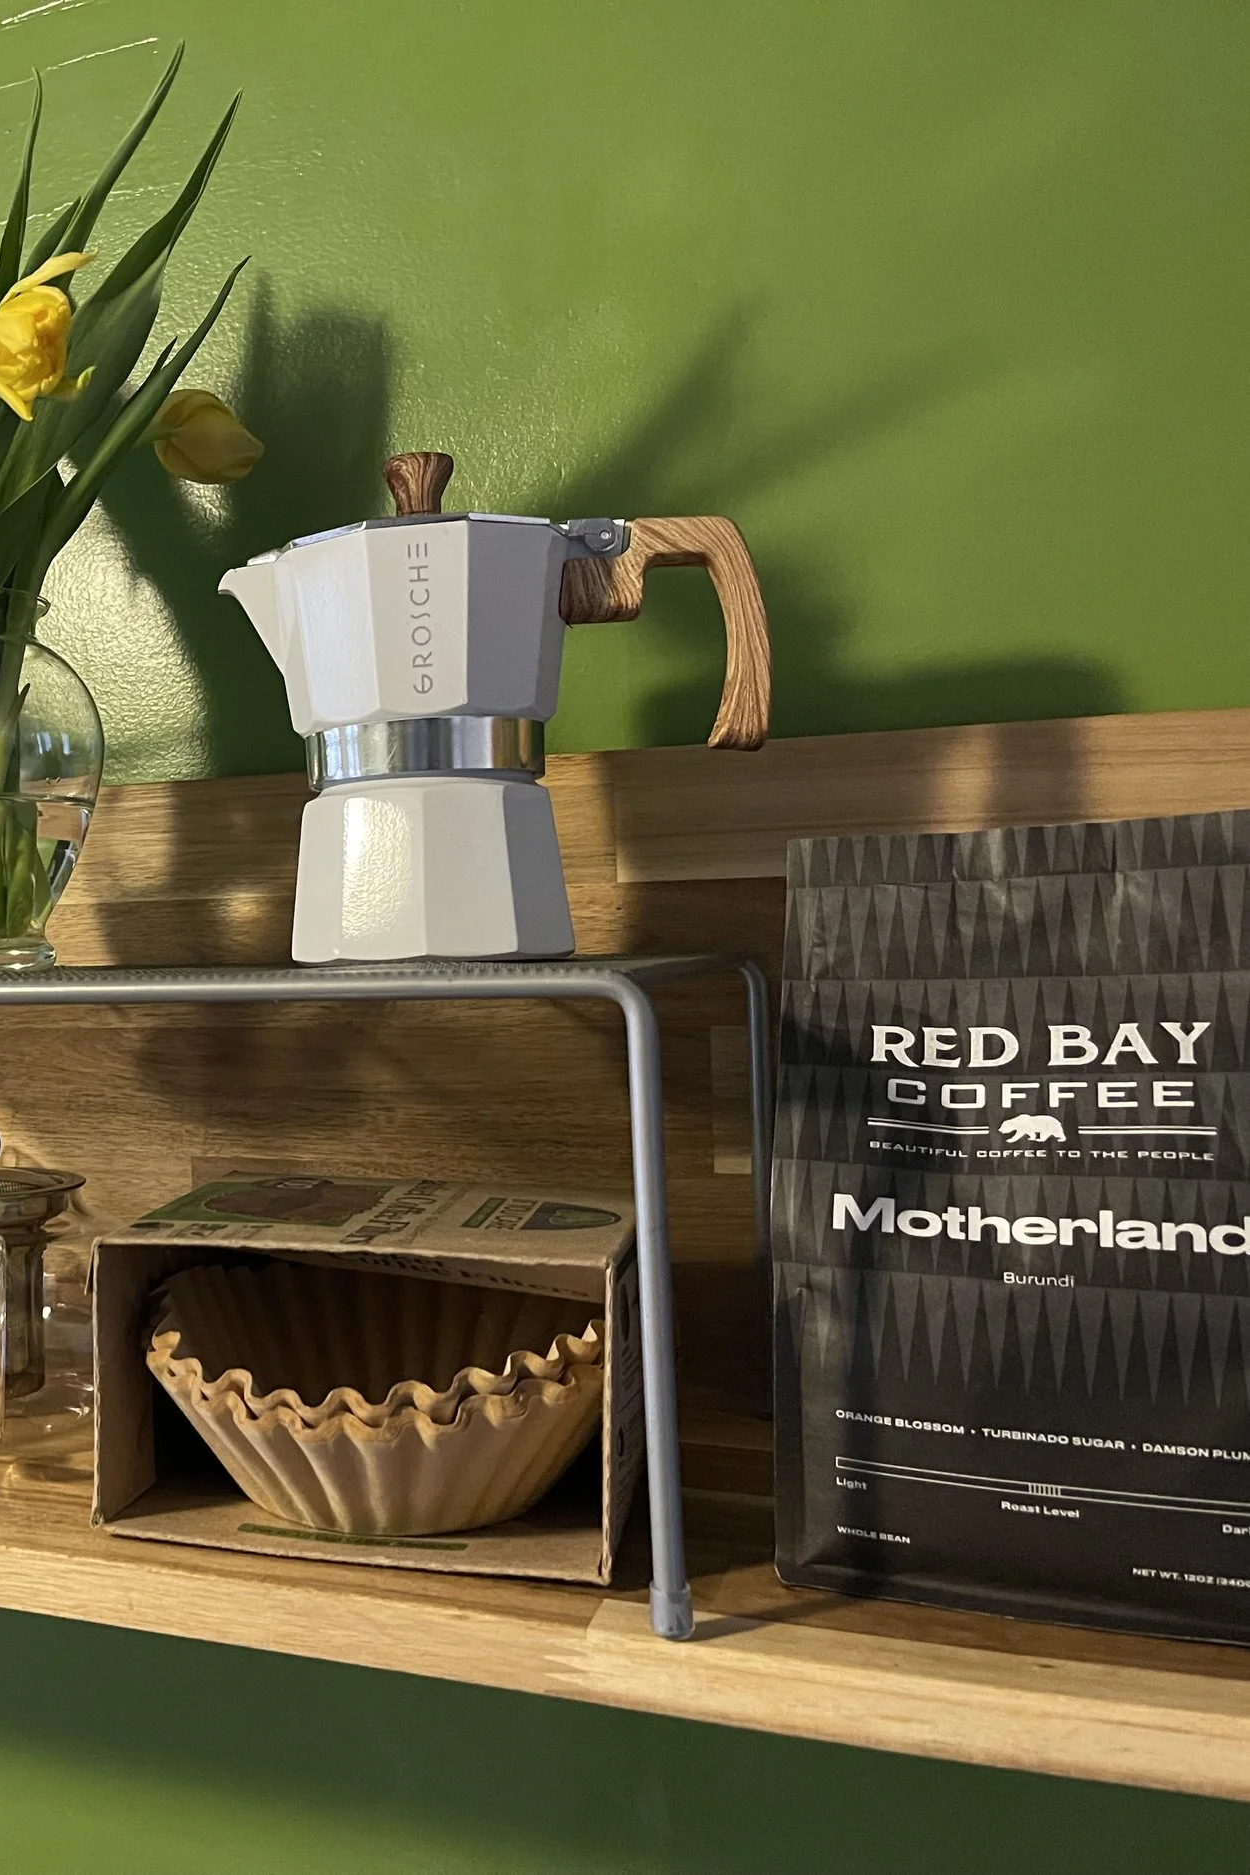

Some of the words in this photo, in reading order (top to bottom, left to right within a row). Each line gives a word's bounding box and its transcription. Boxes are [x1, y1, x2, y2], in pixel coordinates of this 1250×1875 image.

[407, 542, 434, 695] GROSCHE
[870, 1025, 1020, 1068] RED
[1047, 1021, 1211, 1067] BAY
[887, 1078, 1195, 1109] COFFEE
[869, 1140, 969, 1158] BEAUTIFUL
[976, 1150, 1047, 1158] COFFEE
[1056, 1150, 1081, 1158] TO
[1090, 1150, 1129, 1159] THE
[1137, 1151, 1215, 1161] PEOPLE
[832, 1193, 1250, 1256] Motherland
[1003, 1271, 1075, 1288] Burundi
[835, 1409, 892, 1426] ORANGE
[895, 1418, 965, 1434] BLOSSOM
[981, 1428, 1069, 1445] TURBINADO
[1072, 1436, 1125, 1450] SUGAR
[1142, 1443, 1210, 1458] DAMSON
[836, 1476, 867, 1490] Light
[1001, 1501, 1040, 1514] Roast
[1043, 1505, 1080, 1518] Level
[836, 1525, 877, 1540] WHOLE
[879, 1532, 911, 1544] BEAN
[1222, 1523, 1250, 1536] Dar
[1132, 1567, 1157, 1578] NET
[1159, 1570, 1182, 1581] WT.
